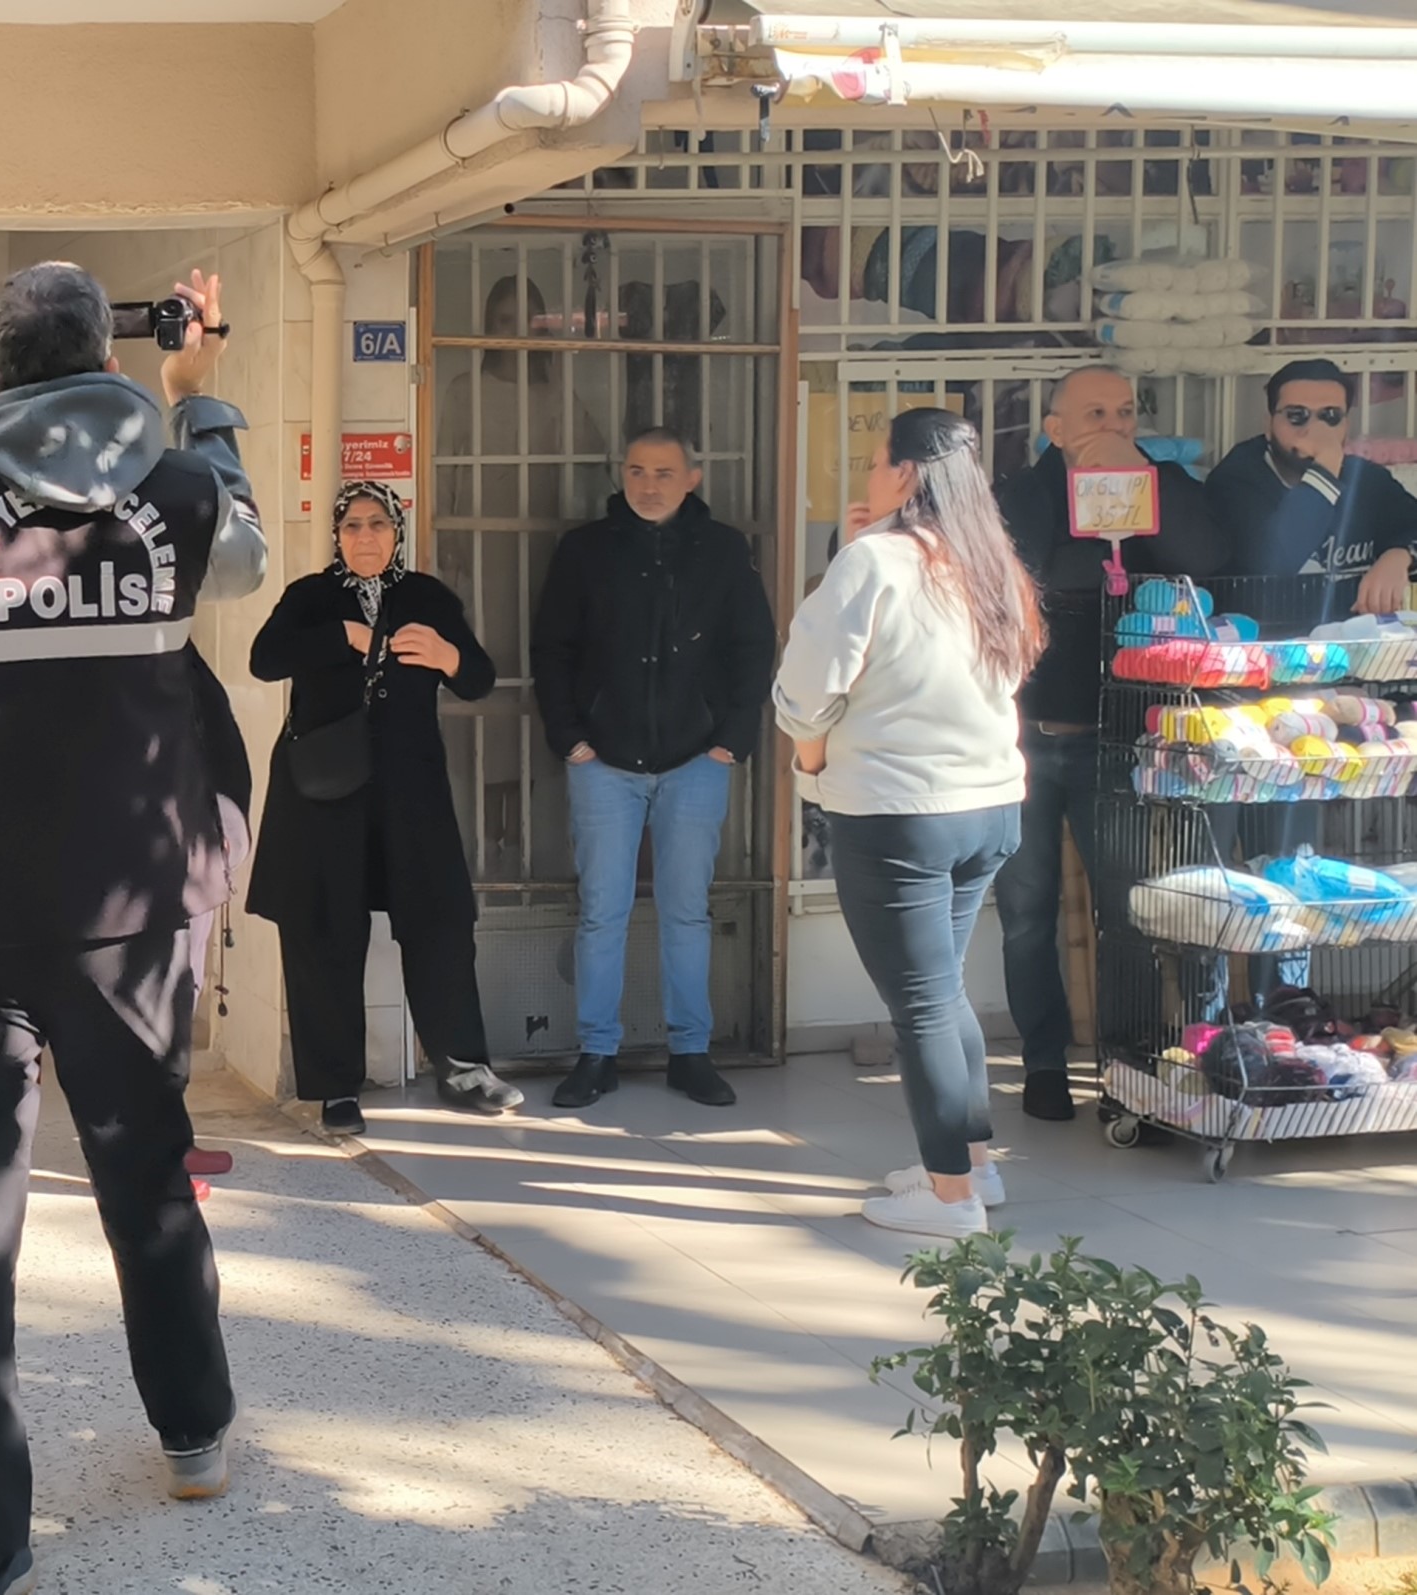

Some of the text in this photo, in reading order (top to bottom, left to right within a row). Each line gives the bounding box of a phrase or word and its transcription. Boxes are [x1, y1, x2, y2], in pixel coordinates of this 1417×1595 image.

[361, 332, 401, 354] 6/A
[343, 440, 389, 451] yerimiz
[343, 451, 372, 462] 7/24
[1092, 505, 1141, 528] 35 TL
[112, 493, 176, 615] CELEME
